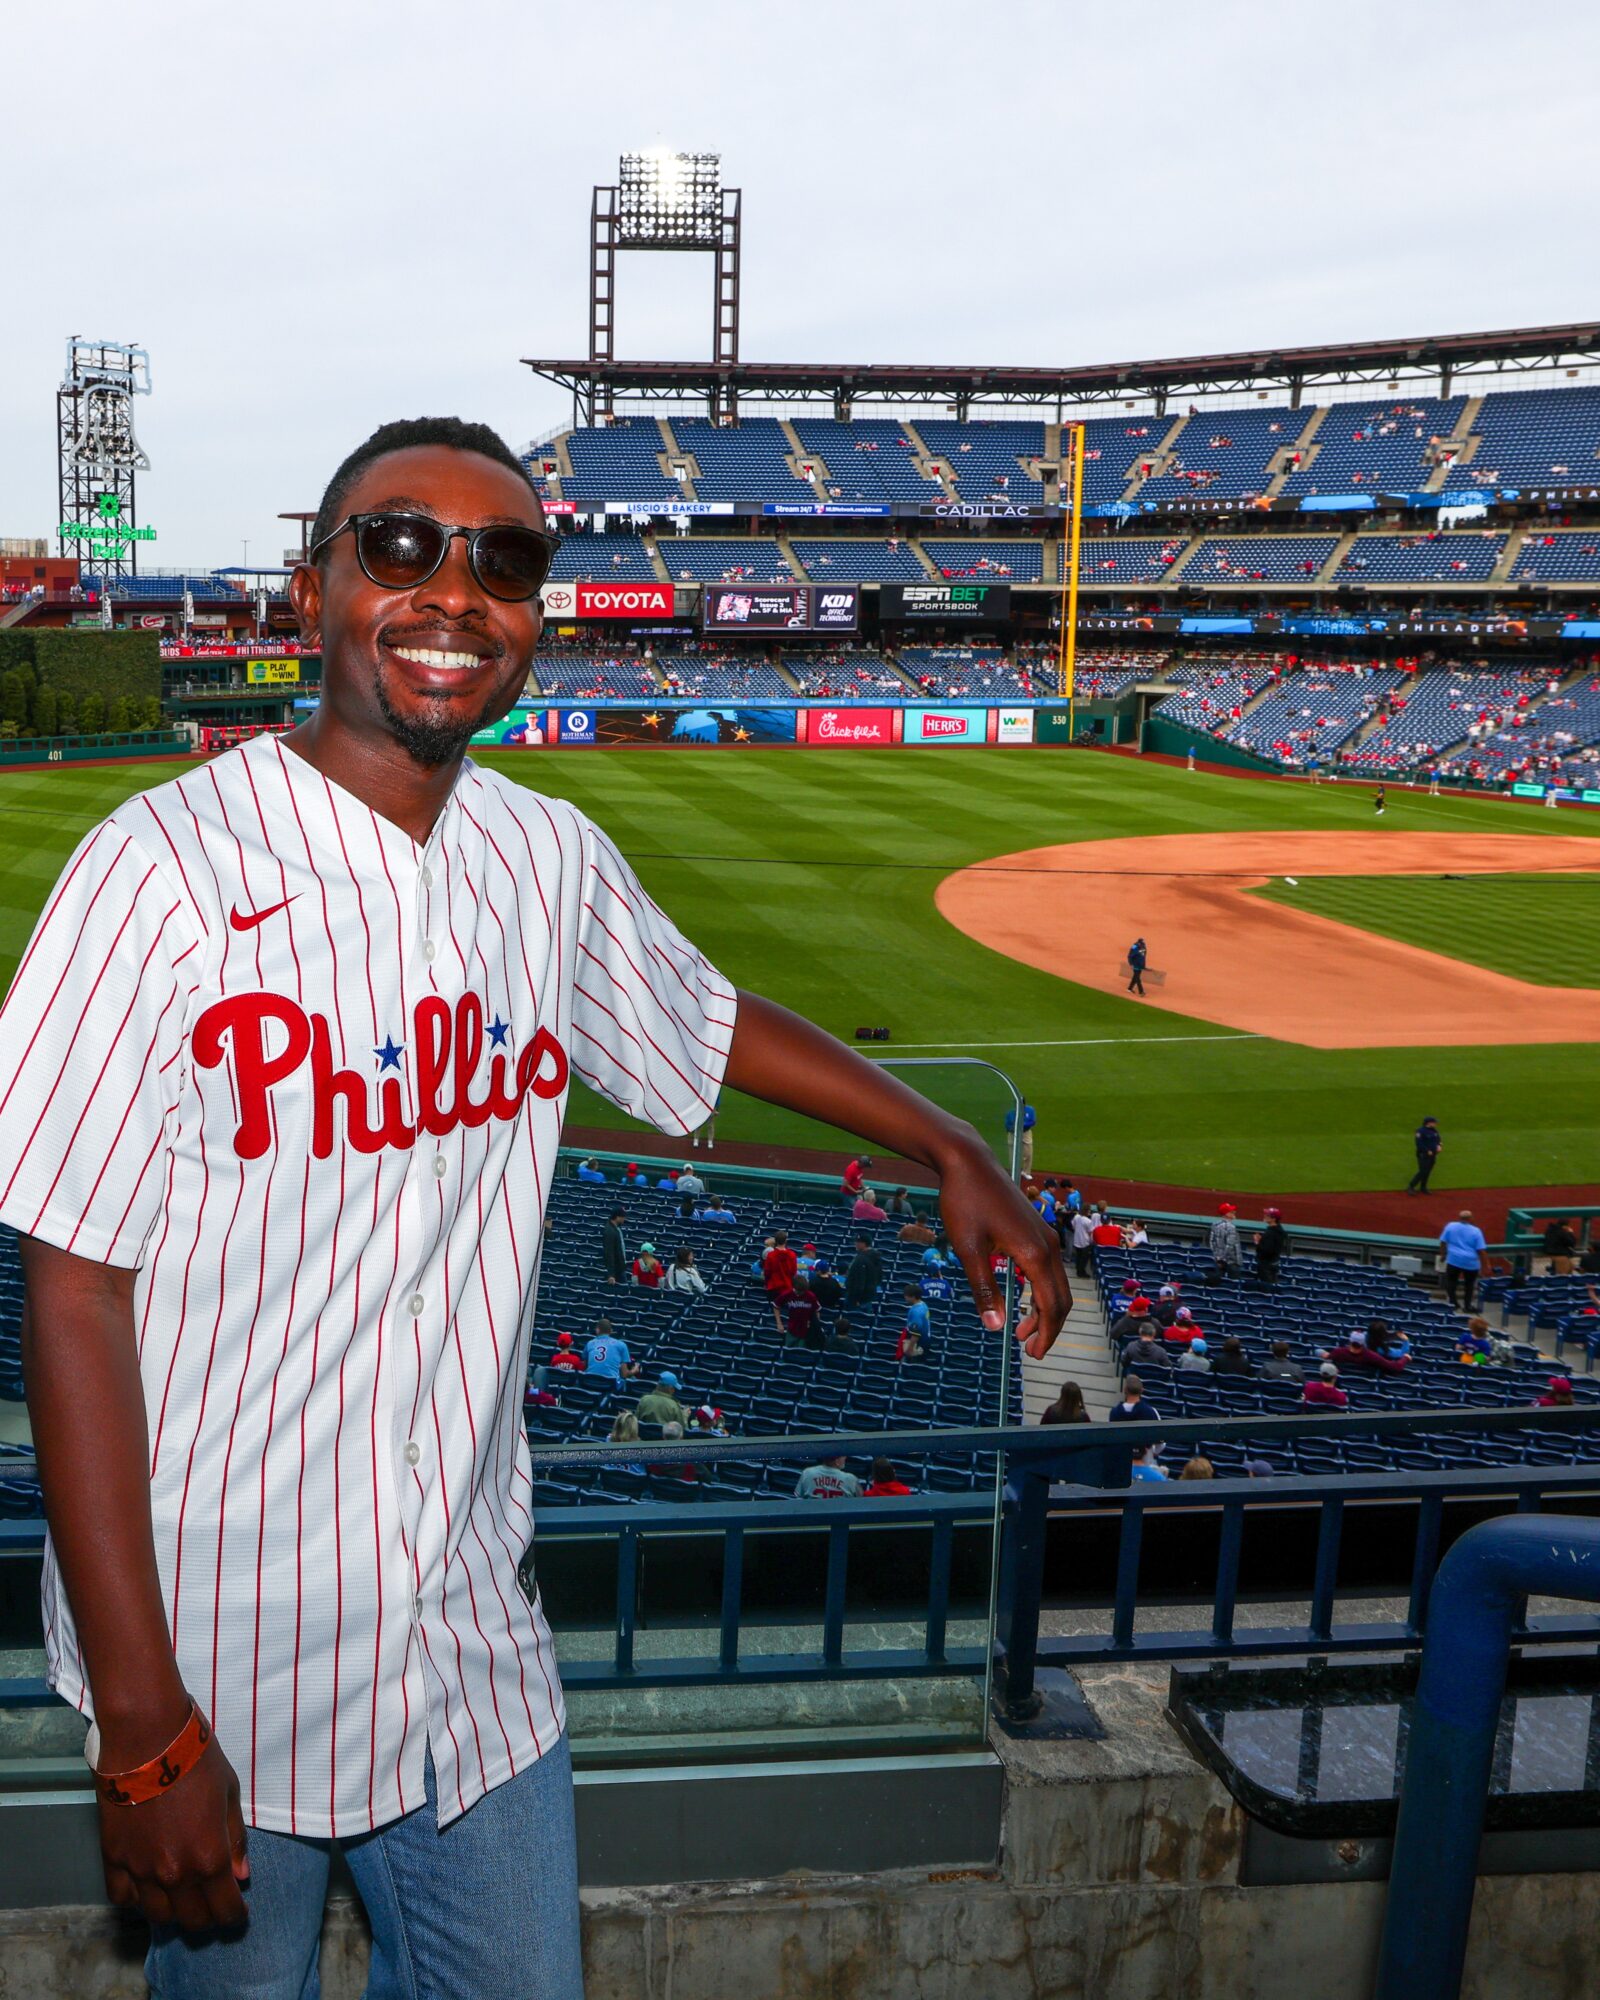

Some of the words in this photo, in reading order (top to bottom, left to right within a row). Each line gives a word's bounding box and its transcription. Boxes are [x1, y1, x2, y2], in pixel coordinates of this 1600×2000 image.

[628, 504, 669, 512] LISCIO'S
[672, 504, 712, 512] BAKERY
[800, 506, 813, 514] 24/7
[935, 506, 1030, 516] CADILLAC
[60, 522, 118, 538] Citizens
[120, 524, 156, 540] Bank
[92, 543, 125, 559] Park
[582, 592, 665, 608] TOYOTA
[902, 587, 951, 600] ESPN
[951, 587, 990, 600] BET
[820, 594, 854, 608] KDI
[270, 664, 287, 672] PLAY
[278, 671, 295, 680] WIN!
[574, 718, 582, 726] R
[818, 712, 880, 738] Chick-fil-A
[926, 718, 962, 732] HERR'S
[1003, 717, 1030, 725] WM
[1052, 715, 1066, 725] 330
[48, 750, 62, 761] 401
[191, 990, 569, 1160] Phillies
[594, 1346, 607, 1362] 3
[812, 1475, 845, 1489] THOME
